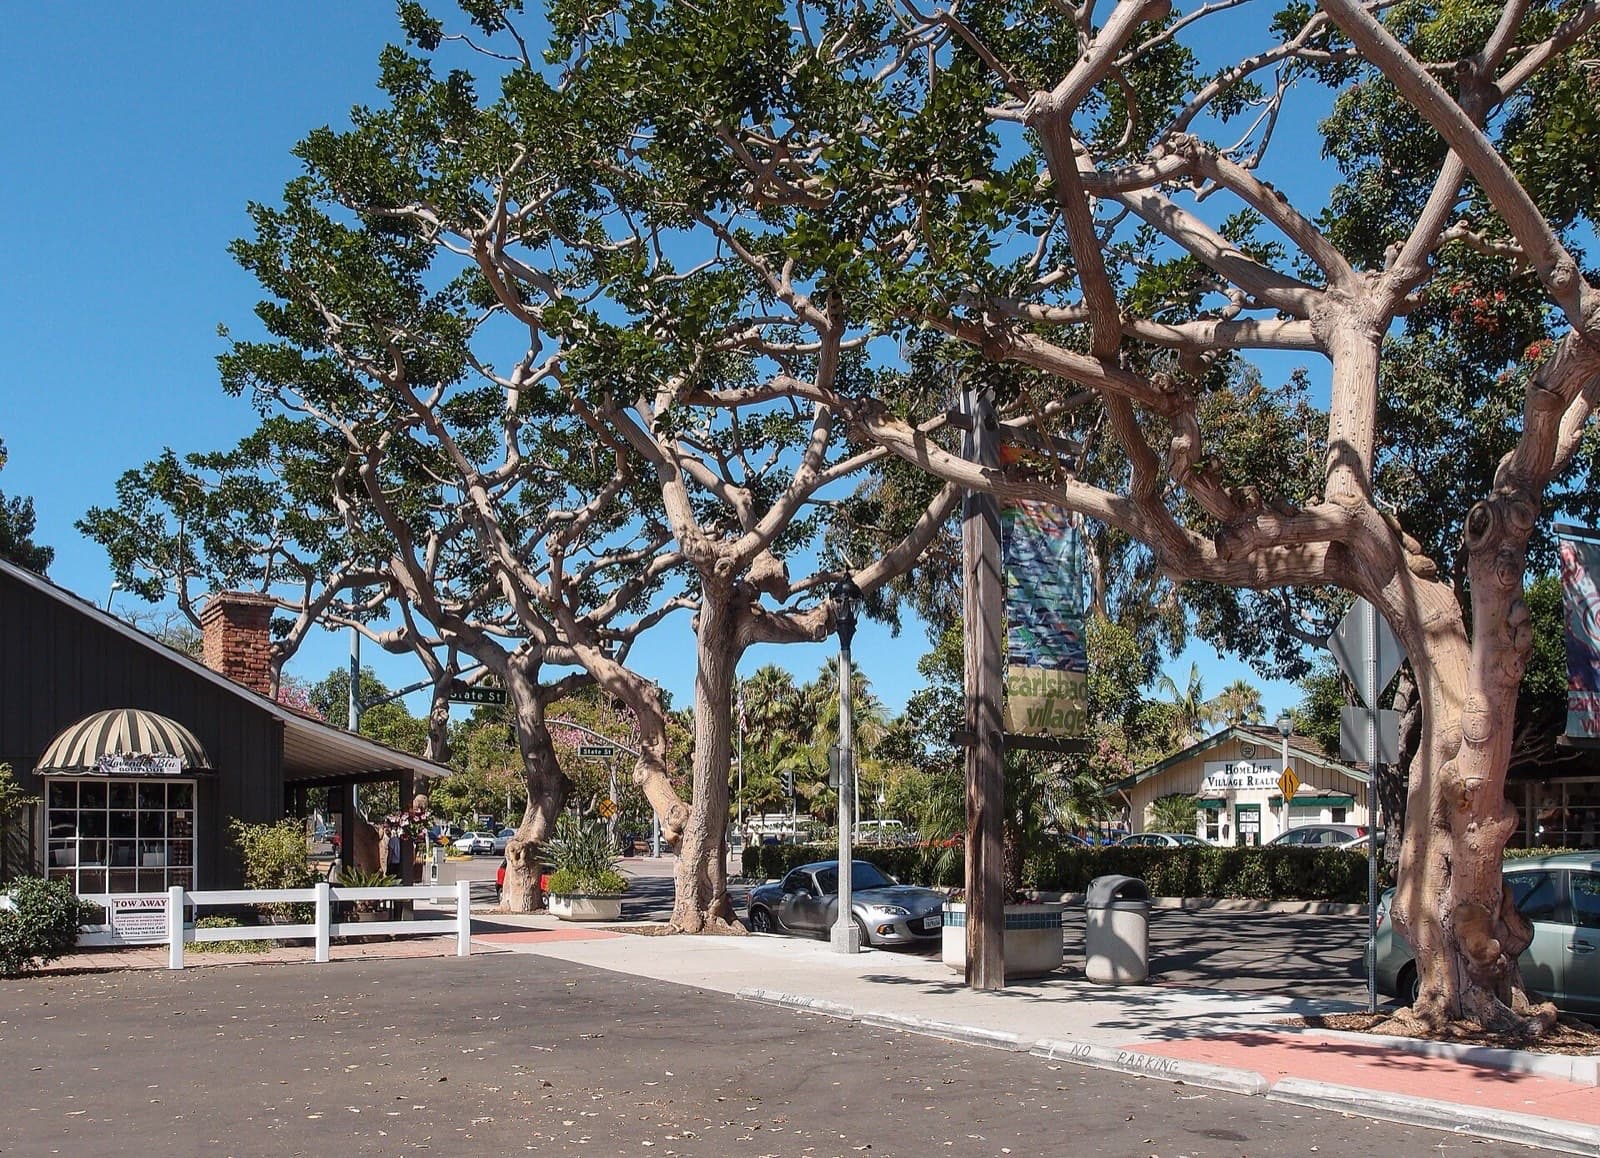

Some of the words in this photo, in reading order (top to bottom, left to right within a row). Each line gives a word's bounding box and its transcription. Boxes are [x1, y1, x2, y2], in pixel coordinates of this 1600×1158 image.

[1008, 670, 1088, 700] carlsbad
[488, 692, 501, 701] St
[1026, 697, 1087, 736] village
[156, 758, 177, 769] Blu
[113, 900, 137, 908] TOW
[1070, 1043, 1092, 1058] NO
[1116, 1051, 1180, 1072] PARKING
